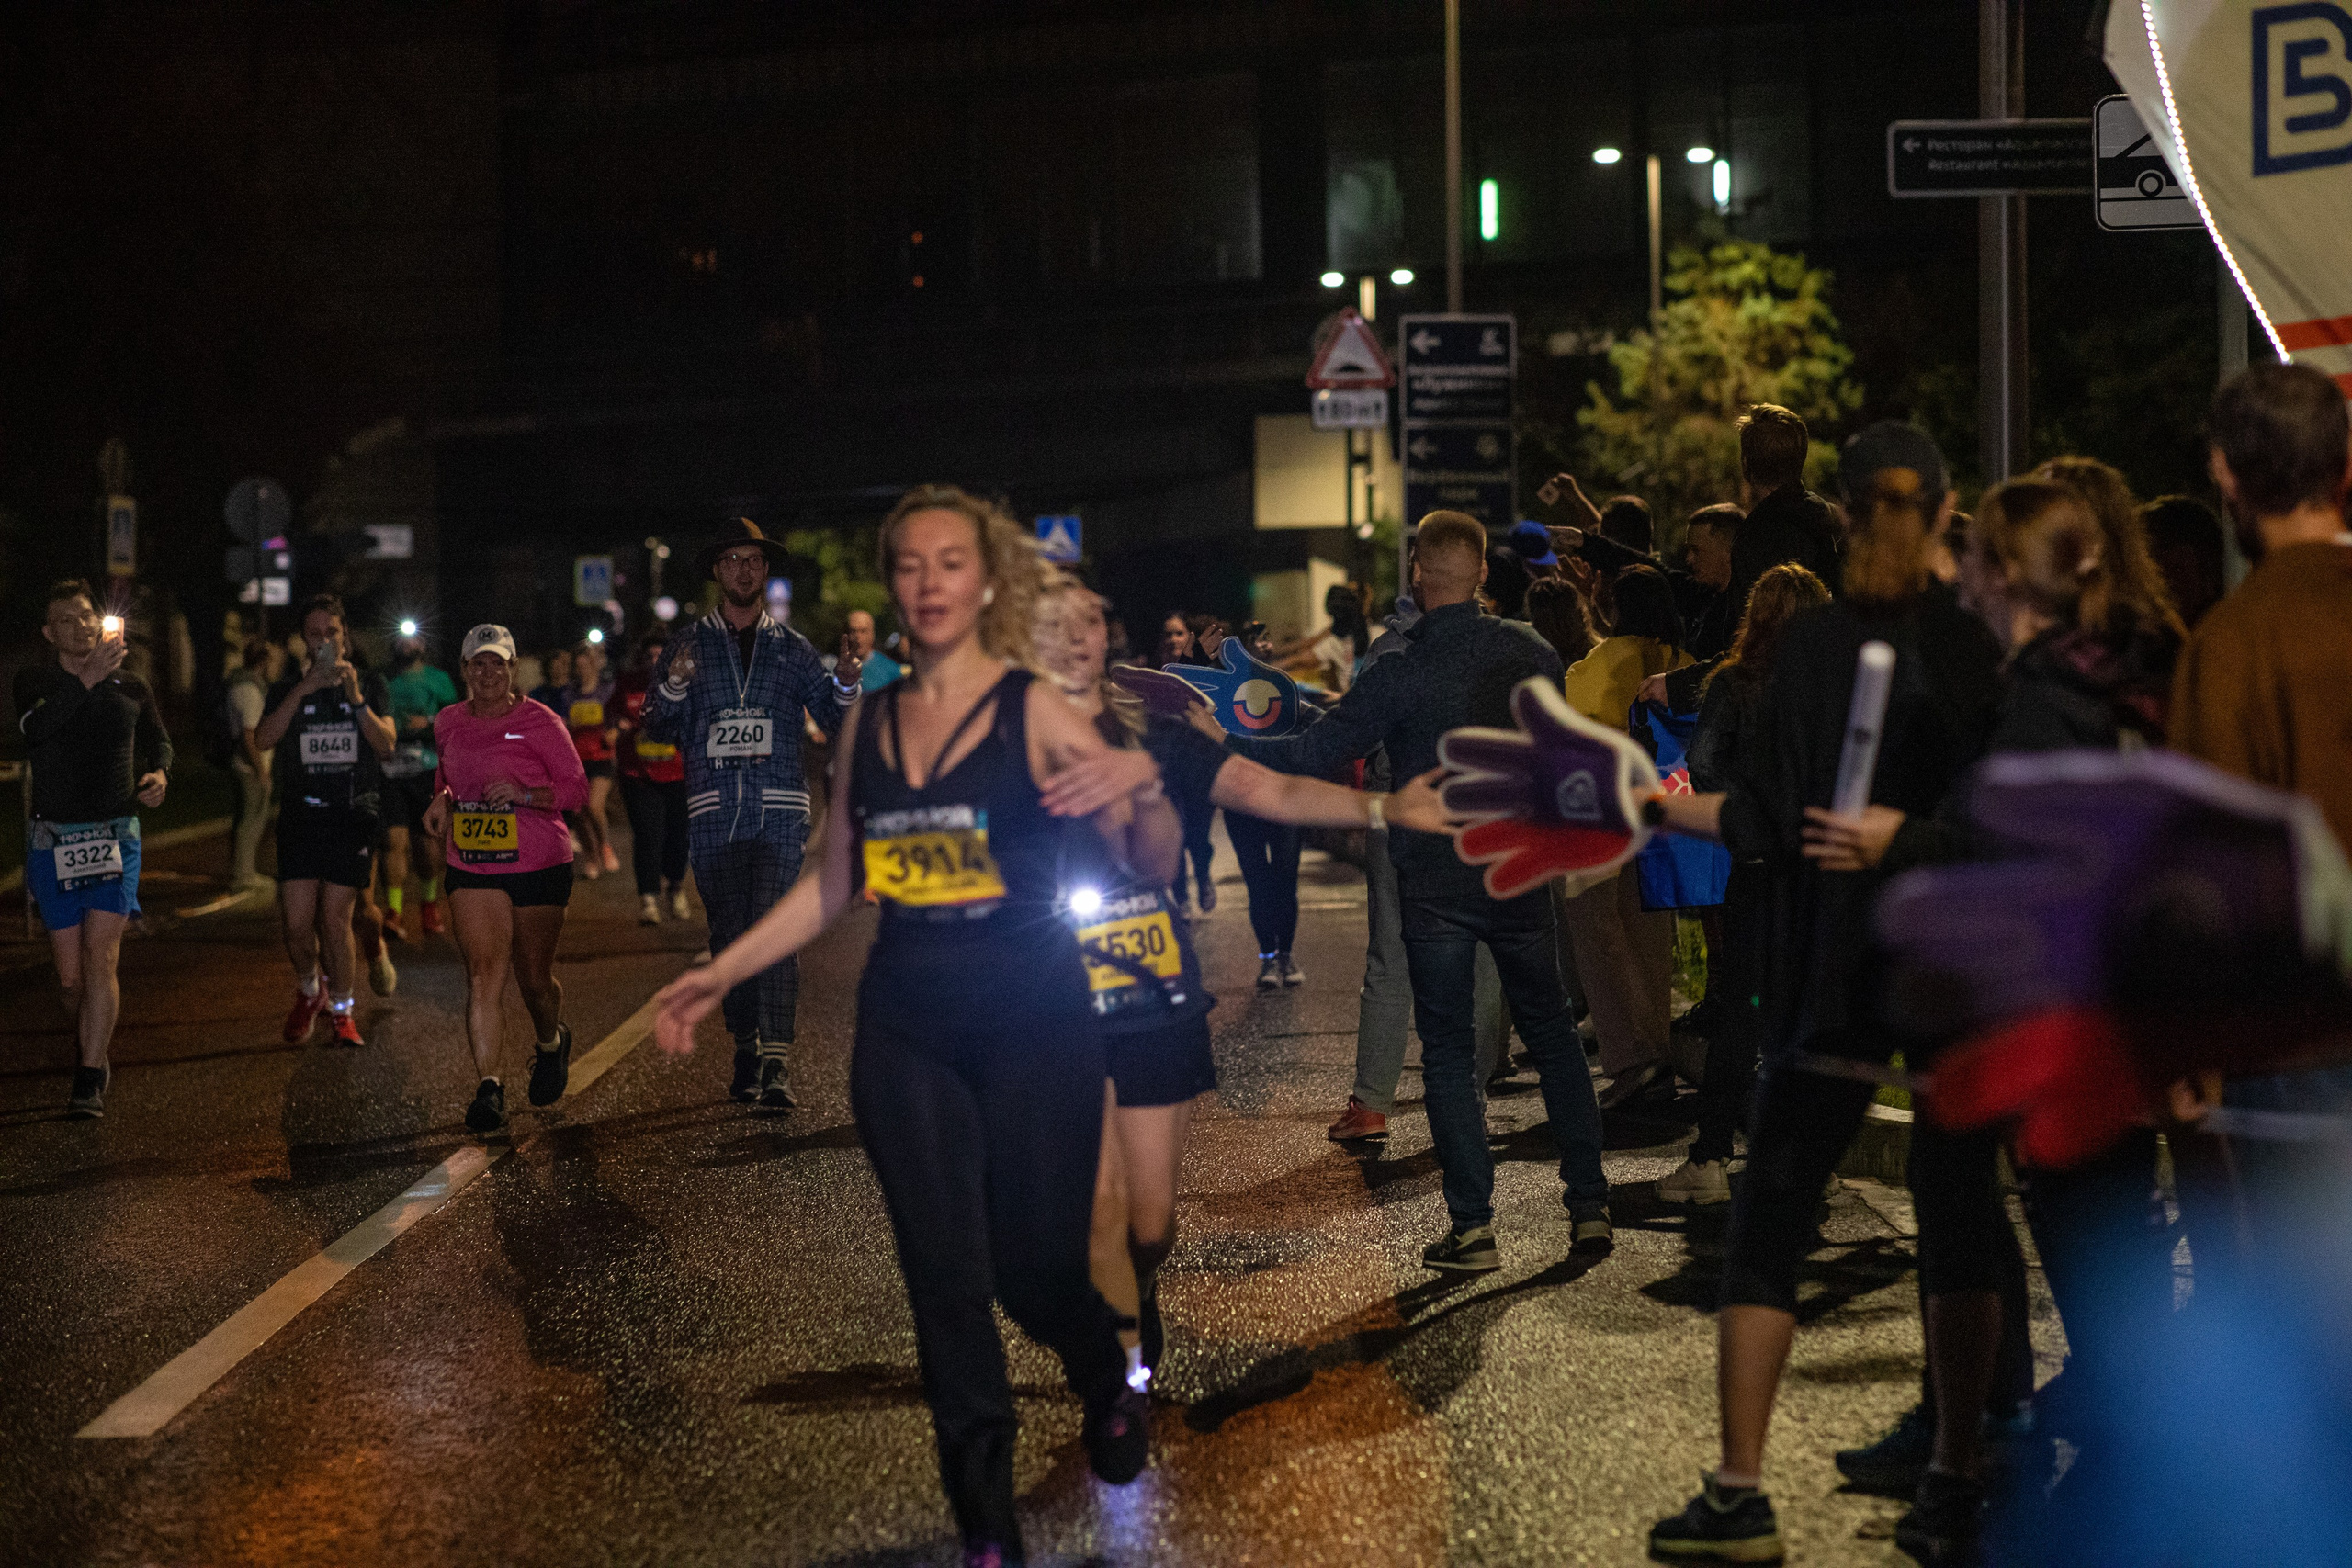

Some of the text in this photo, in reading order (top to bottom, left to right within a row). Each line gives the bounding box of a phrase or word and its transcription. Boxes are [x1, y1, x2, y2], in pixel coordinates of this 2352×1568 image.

[717, 725, 763, 745] 2260
[309, 738, 351, 753] 8648
[462, 818, 509, 838] 3743
[64, 845, 113, 867] 3322
